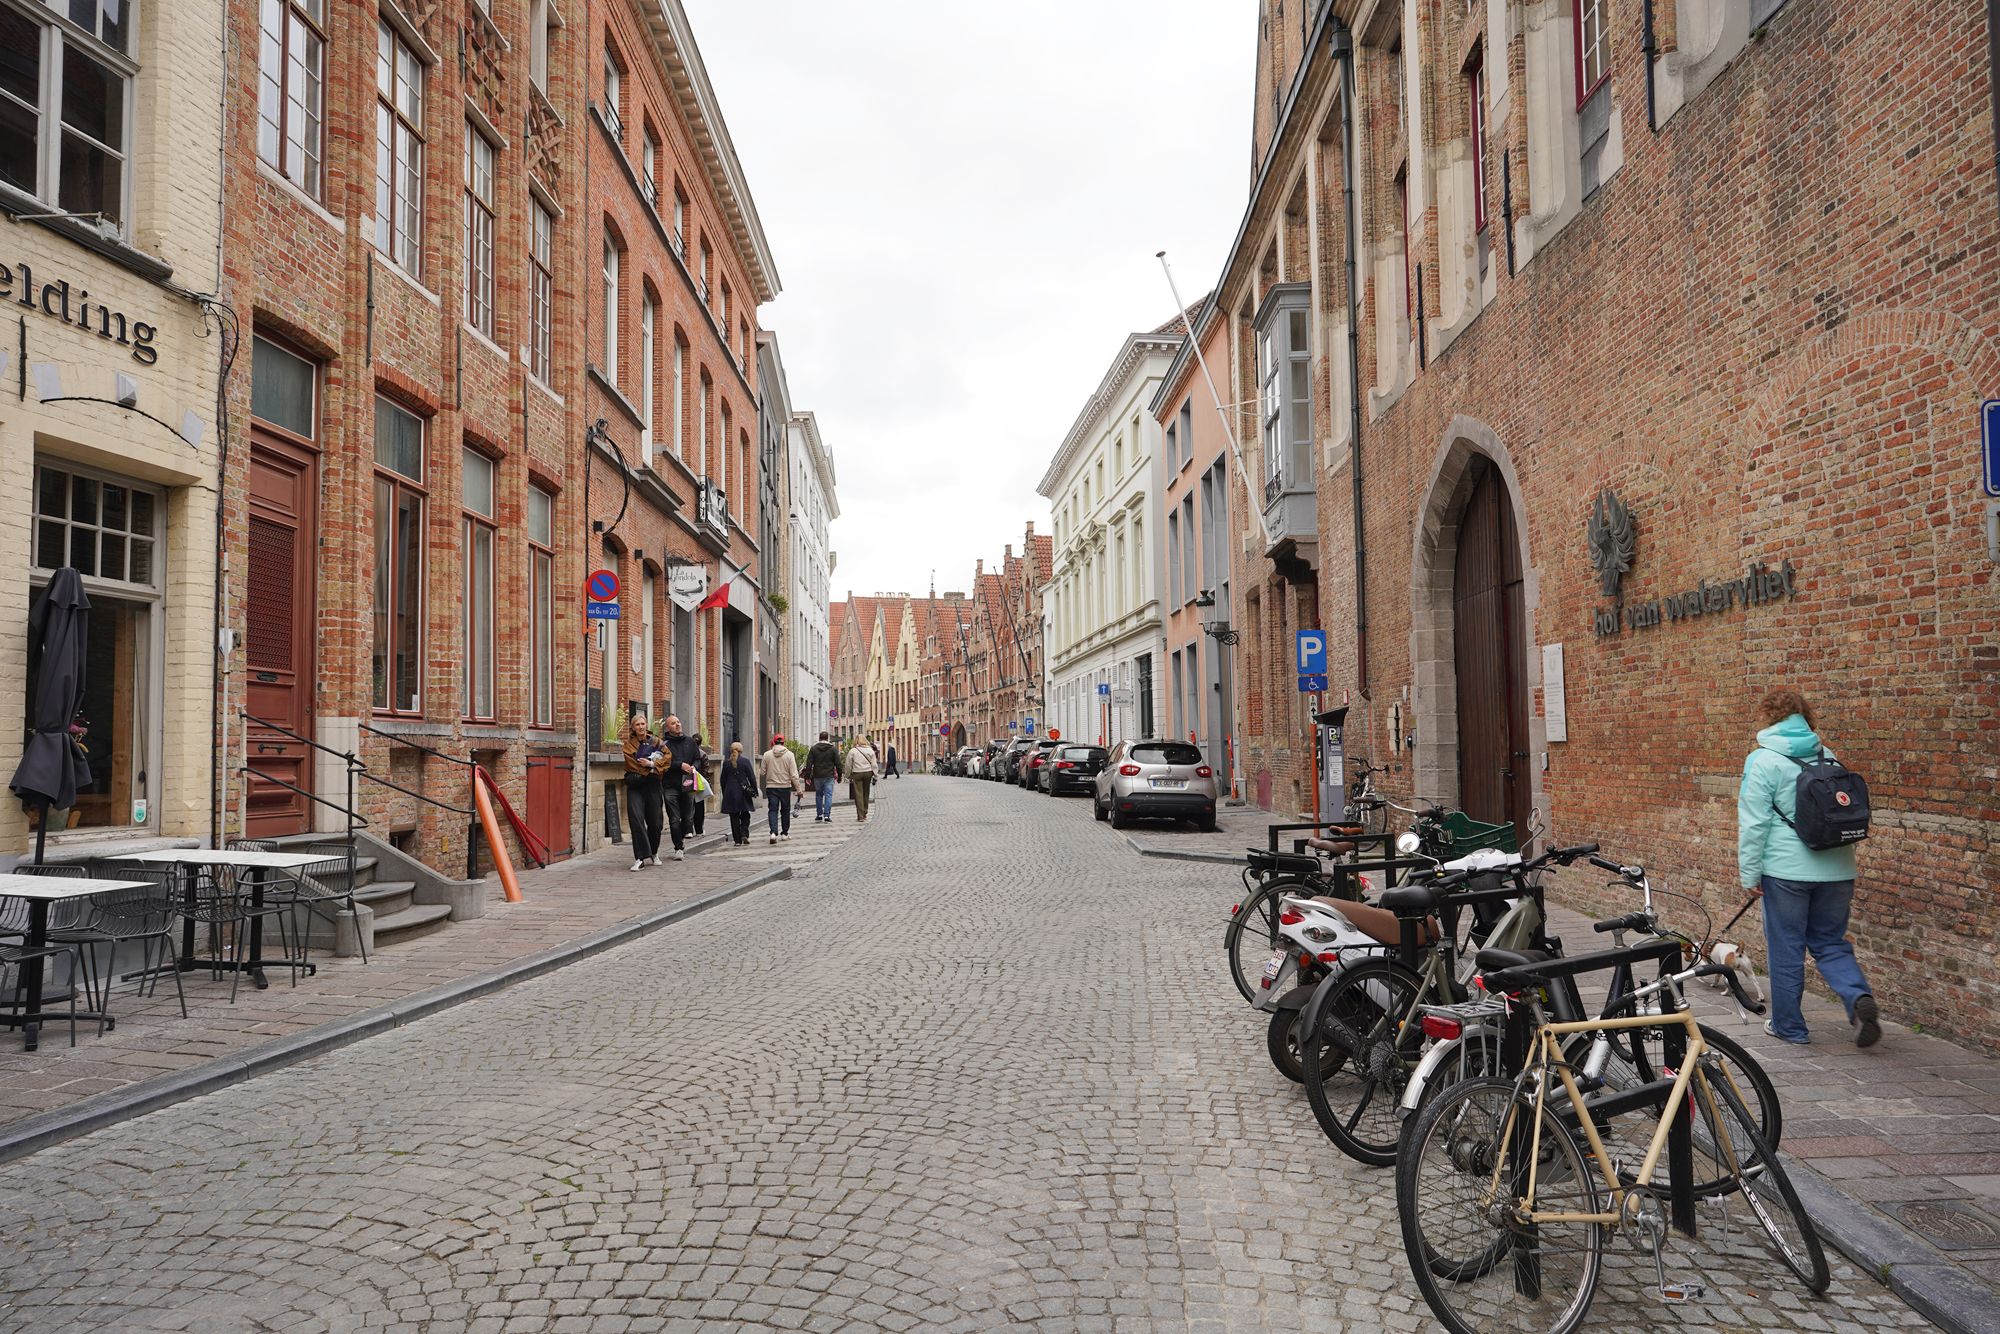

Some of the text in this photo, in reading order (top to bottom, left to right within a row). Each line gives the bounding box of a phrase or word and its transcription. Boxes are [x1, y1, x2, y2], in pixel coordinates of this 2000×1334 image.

[1593, 558, 1797, 636] hof van watervliet
[1301, 637, 1322, 668] P
